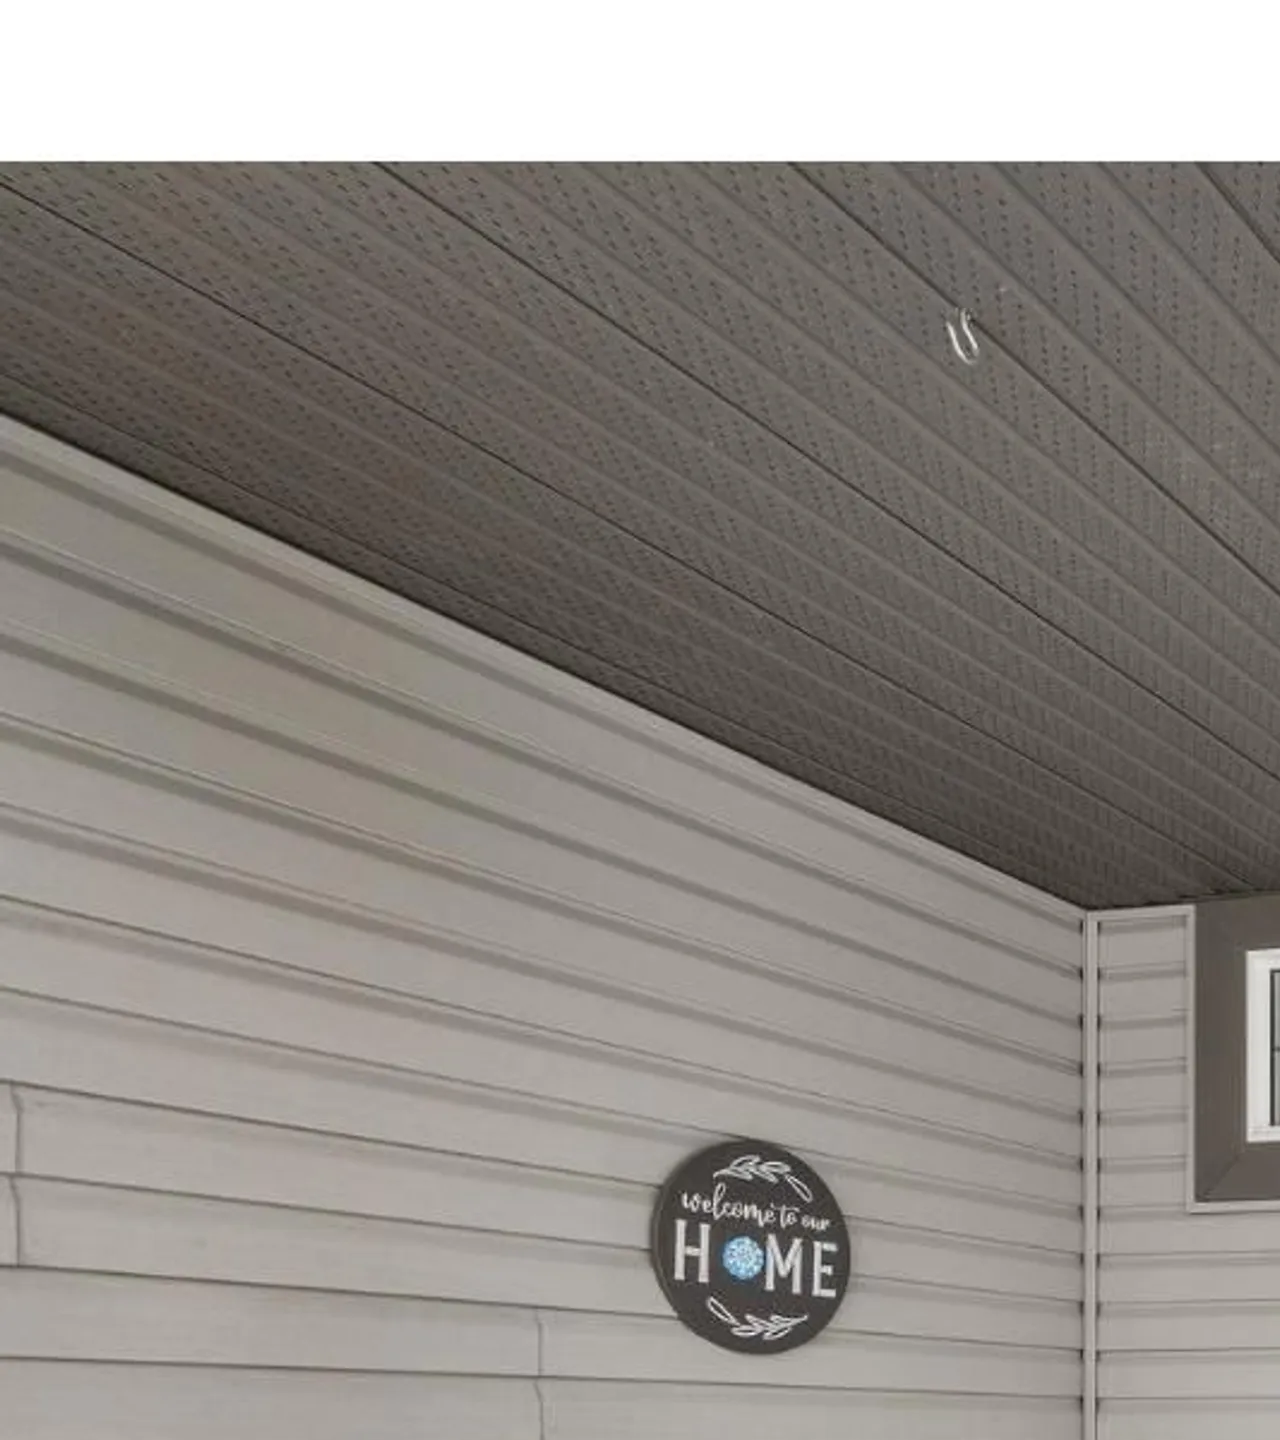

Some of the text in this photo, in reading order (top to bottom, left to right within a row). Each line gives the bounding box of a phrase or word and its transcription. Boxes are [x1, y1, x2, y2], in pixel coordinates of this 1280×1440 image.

[681, 1182, 832, 1231] welcome to our
[674, 1219, 838, 1298] HOME
